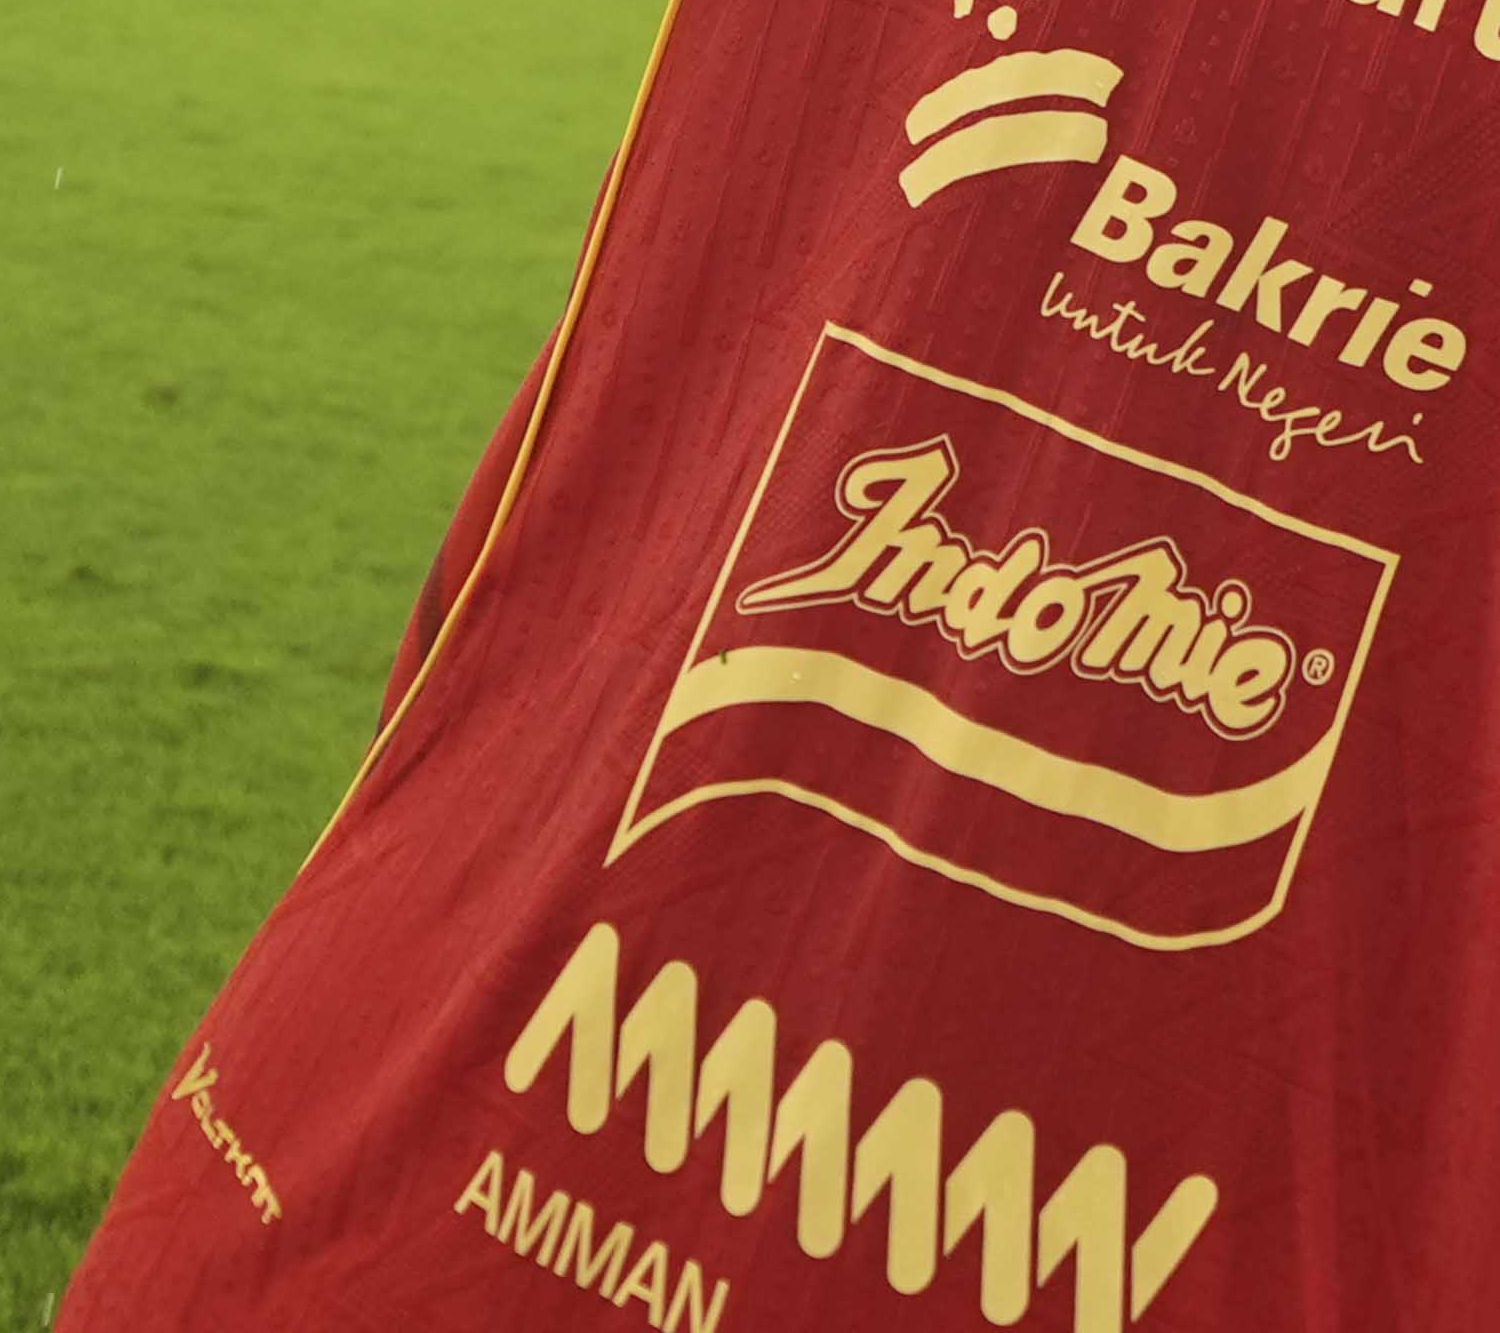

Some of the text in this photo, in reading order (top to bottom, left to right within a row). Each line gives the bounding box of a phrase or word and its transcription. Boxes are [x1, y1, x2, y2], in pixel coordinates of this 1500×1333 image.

[1040, 272, 1424, 463] Untuk Negeri
[1070, 154, 1467, 391] Bakrie
[453, 1149, 731, 1333] AMMAN
